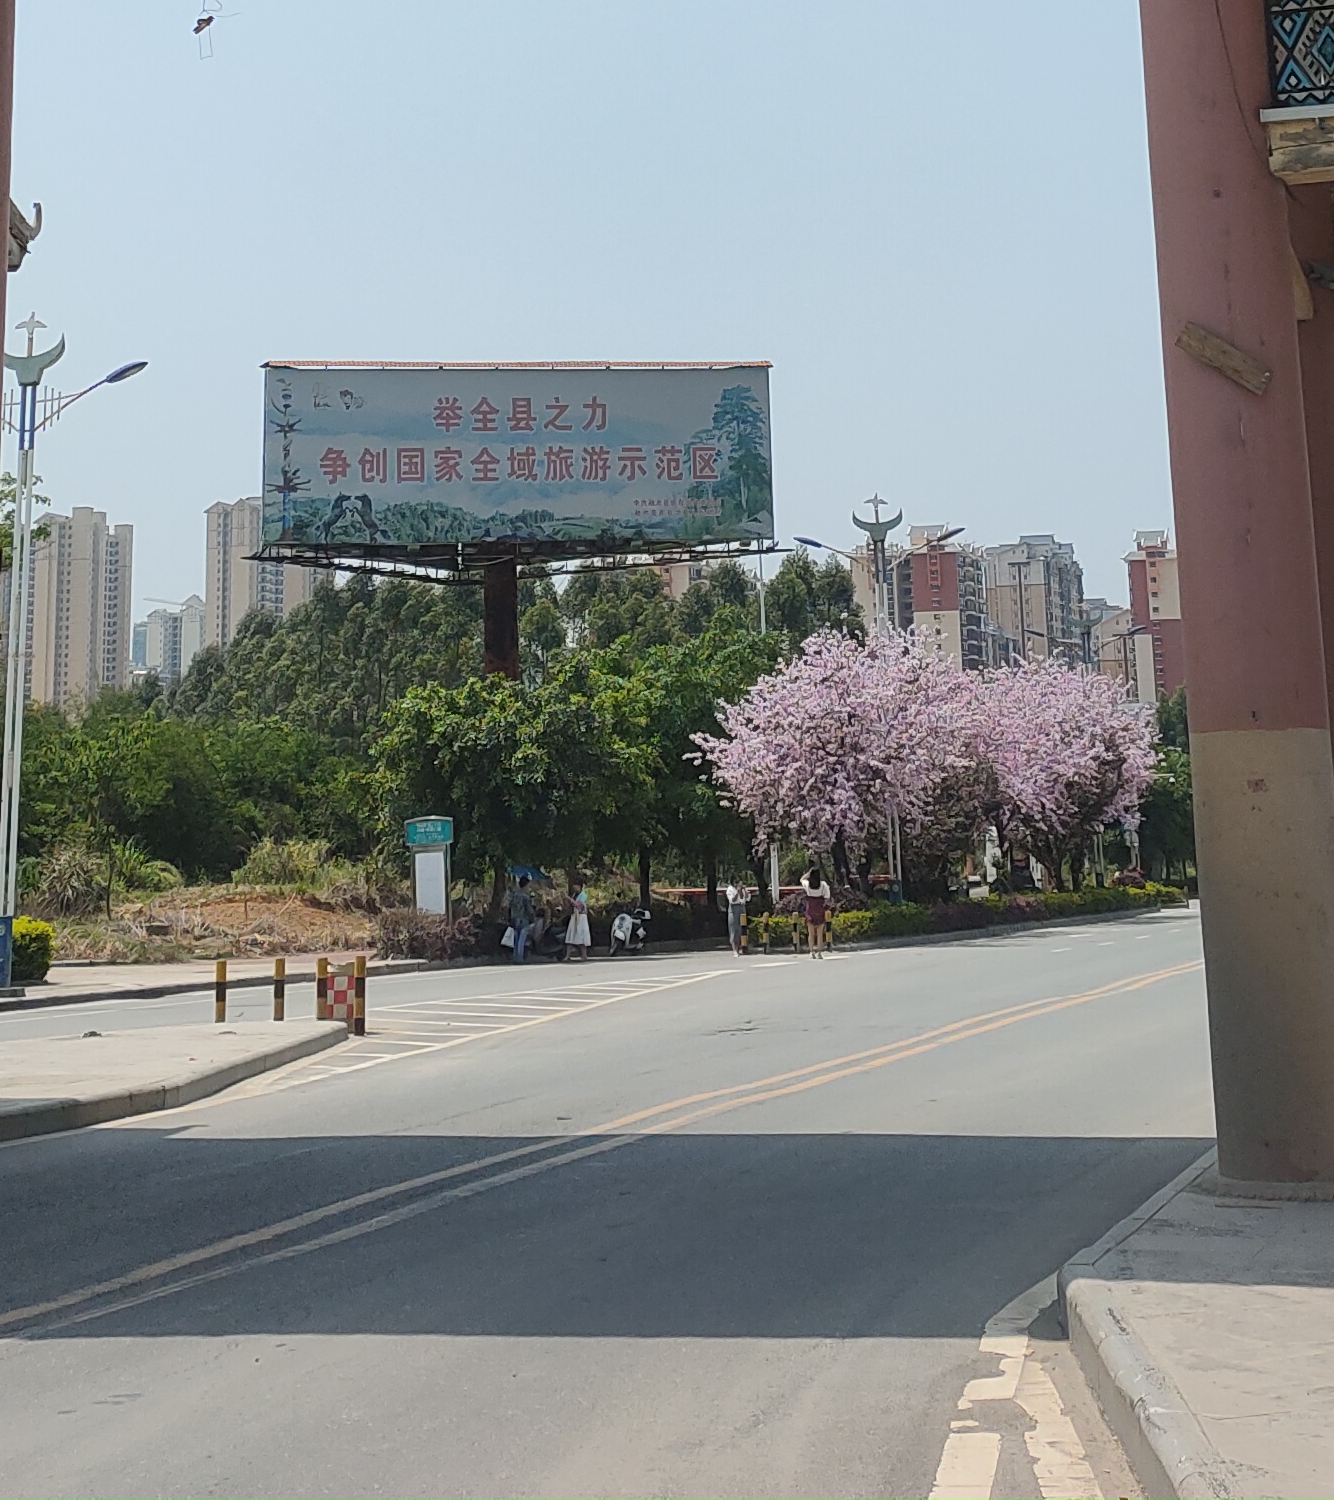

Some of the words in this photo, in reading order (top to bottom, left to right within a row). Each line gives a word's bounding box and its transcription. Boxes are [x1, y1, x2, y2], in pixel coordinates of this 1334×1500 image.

[432, 395, 609, 433] 举全县之力
[319, 446, 721, 485] 争创国家全域旅游示范区
